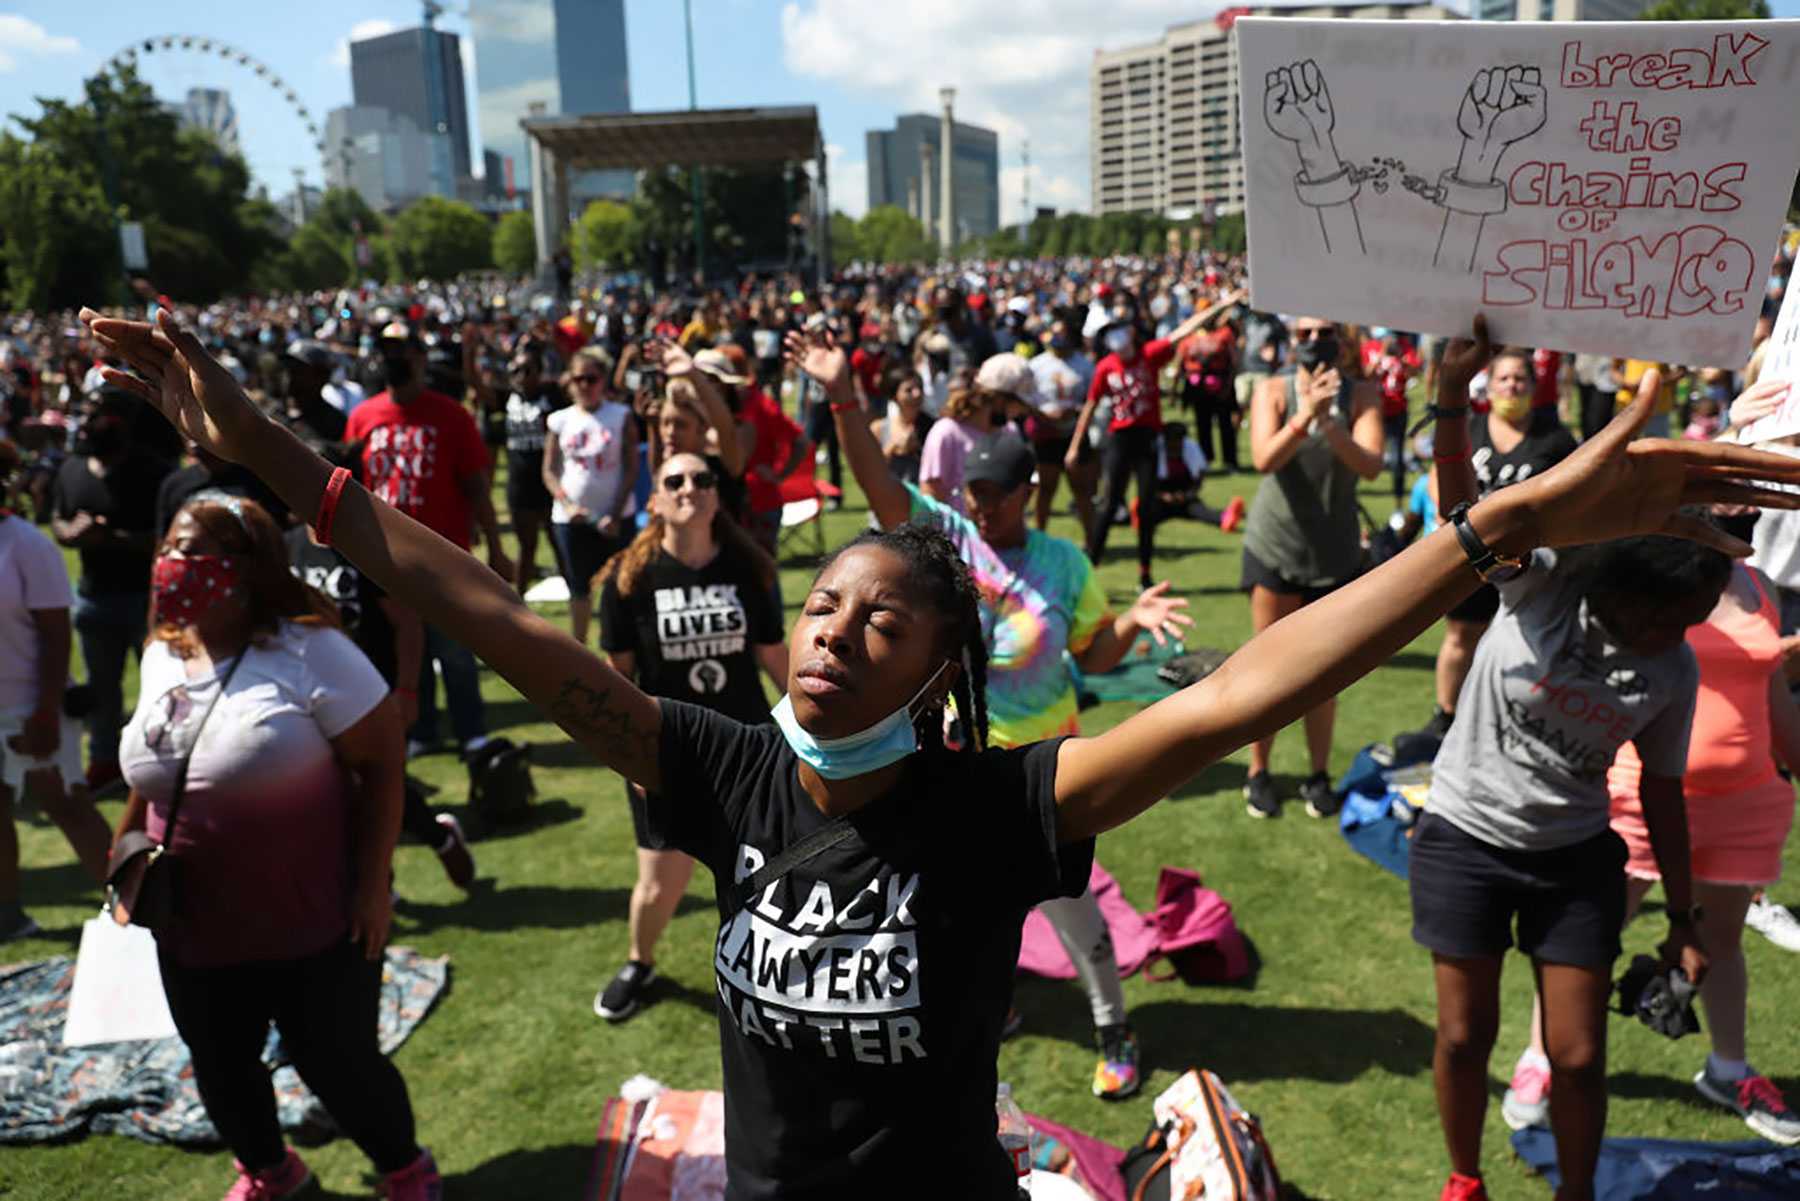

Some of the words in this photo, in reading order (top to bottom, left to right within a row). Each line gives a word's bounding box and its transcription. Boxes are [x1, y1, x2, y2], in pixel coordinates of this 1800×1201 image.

[1579, 100, 1682, 153] the
[655, 584, 741, 612] BLACK
[664, 611, 742, 638] LIVES
[661, 637, 745, 660] MATTER
[1530, 672, 1634, 742] HOPE
[717, 918, 913, 1001] LAWYERS
